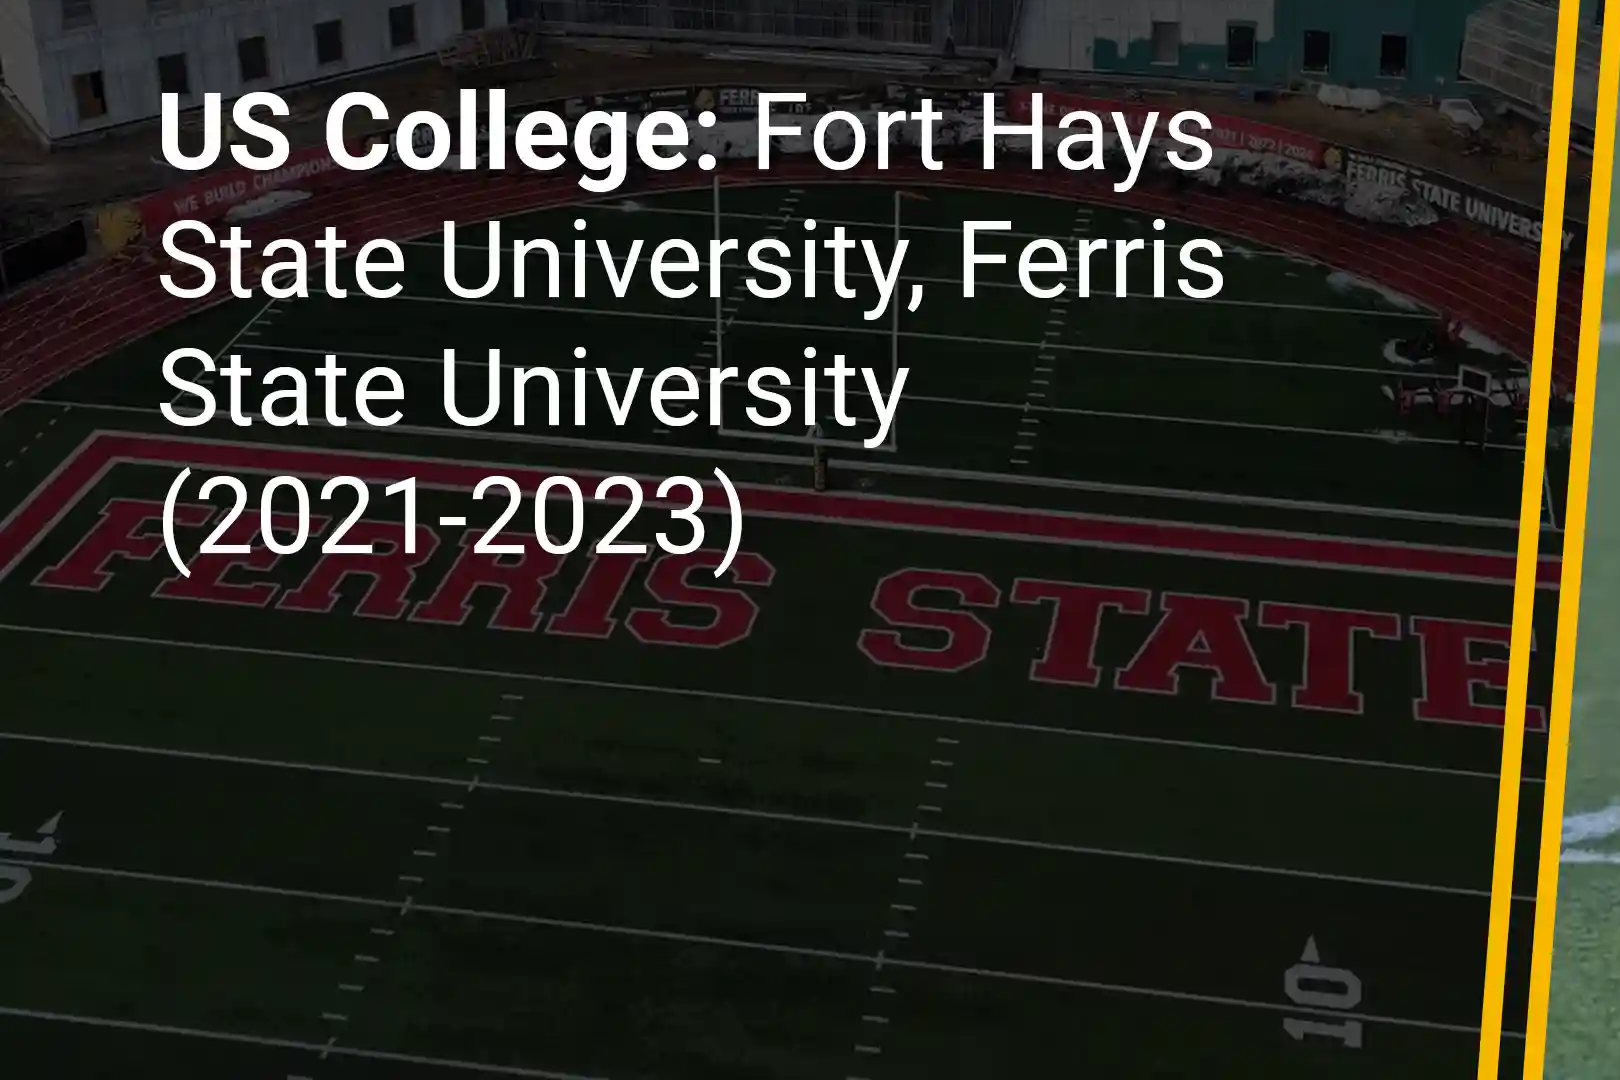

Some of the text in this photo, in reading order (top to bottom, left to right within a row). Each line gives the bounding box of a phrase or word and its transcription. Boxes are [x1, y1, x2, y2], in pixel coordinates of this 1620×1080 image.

[173, 193, 201, 217] WE
[204, 180, 247, 207] BUILD
[1464, 196, 1576, 253] UNIVERSY
[31, 497, 1549, 733] FERRIS STATE
[1283, 962, 1363, 1050] 10
